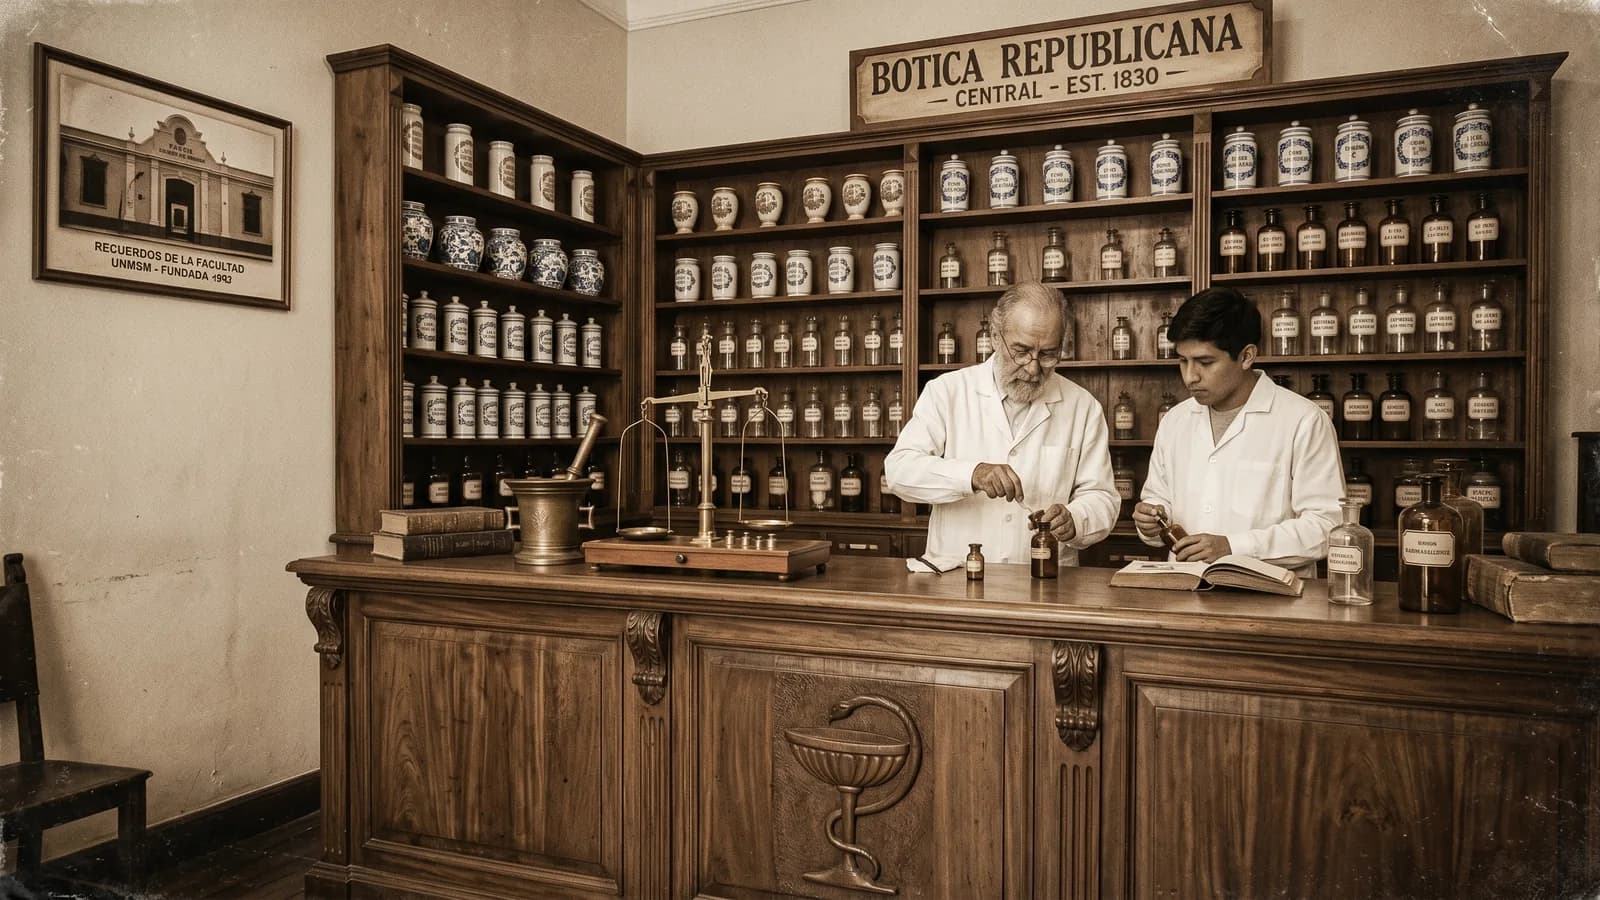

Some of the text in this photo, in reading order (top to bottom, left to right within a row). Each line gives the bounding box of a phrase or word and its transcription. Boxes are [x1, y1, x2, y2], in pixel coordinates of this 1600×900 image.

[872, 13, 1242, 95] BOTICA REPUBLICANA
[956, 81, 1042, 107] CENTRAL
[1066, 72, 1106, 94] EST.
[1113, 67, 1159, 89] 1830
[95, 241, 245, 273] RECUERDOS DE LA FACULTAD
[111, 258, 152, 272] UNMSM
[161, 265, 208, 280] FUNDADA
